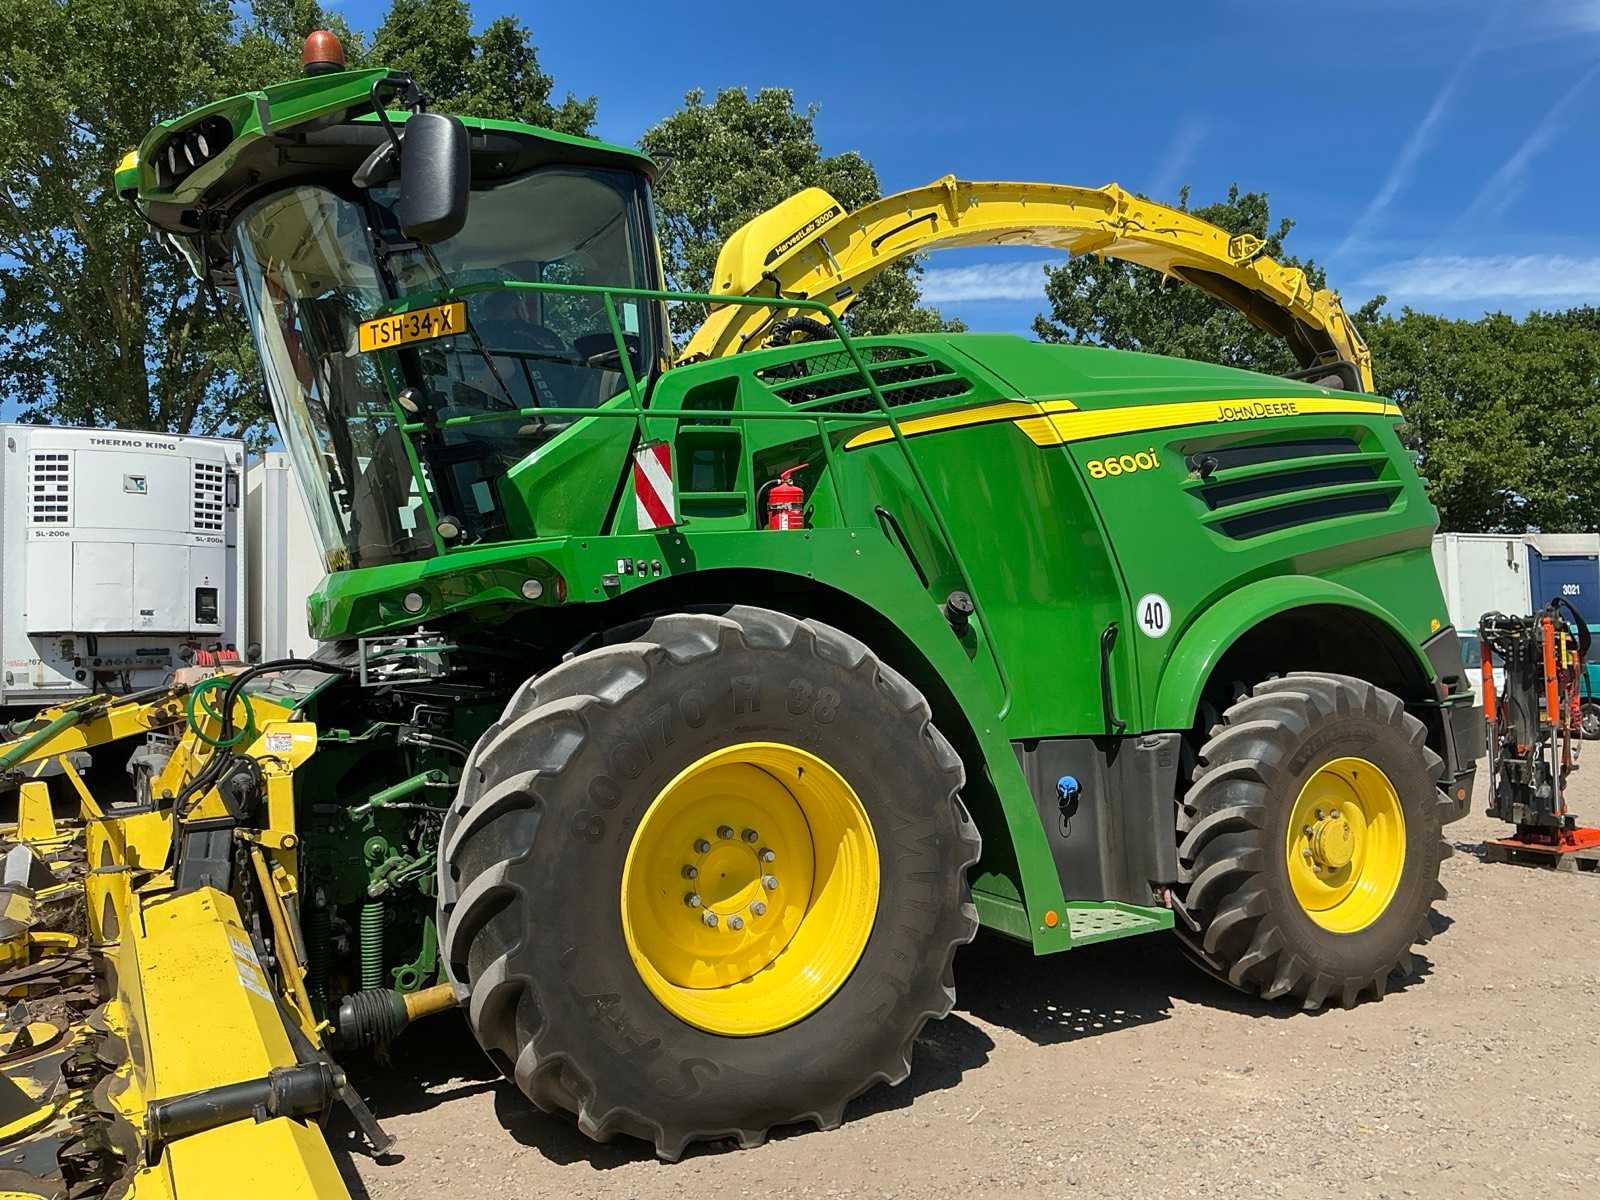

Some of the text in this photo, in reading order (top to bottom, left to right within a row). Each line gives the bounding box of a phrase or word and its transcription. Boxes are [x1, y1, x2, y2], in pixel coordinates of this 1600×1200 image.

[775, 210, 834, 256] HarvestLab 3000
[370, 308, 453, 345] TSH-34-X
[1217, 402, 1299, 420] JOHN DEERE
[89, 438, 176, 451] THERMO KING
[1086, 447, 1161, 480] 8600i
[1562, 584, 1581, 596] 3021
[1144, 602, 1164, 630] 40
